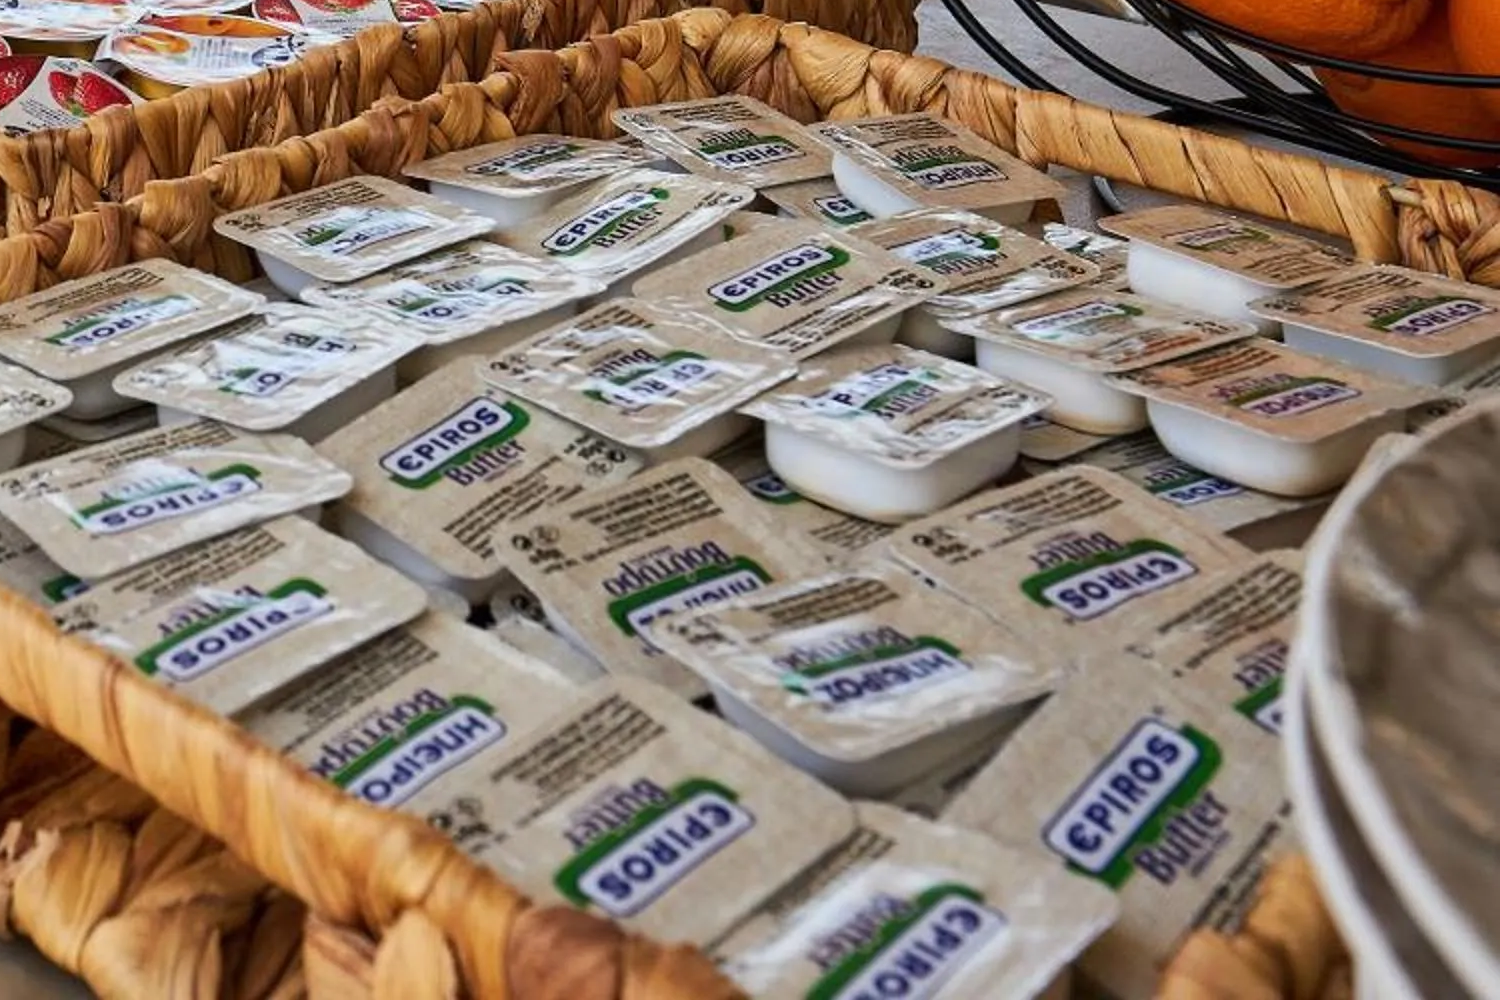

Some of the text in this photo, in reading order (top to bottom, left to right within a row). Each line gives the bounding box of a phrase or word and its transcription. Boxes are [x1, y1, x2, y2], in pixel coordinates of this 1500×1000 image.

[555, 195, 645, 247] EPIR
[723, 249, 822, 298] EPIROS
[763, 270, 843, 311] Butter
[396, 406, 500, 472] EPIROS
[444, 437, 526, 487] Butter
[1028, 531, 1125, 571] Butter
[1058, 556, 1179, 611] EPIROS
[171, 600, 318, 671] PIROS
[360, 711, 491, 802] ΗΠΕΙΡΟ
[563, 777, 670, 850] Butter
[1065, 734, 1181, 854] EPIROS
[597, 802, 733, 901] EPIROS
[1132, 790, 1230, 888] Butter
[852, 907, 982, 1000] EPIRO
